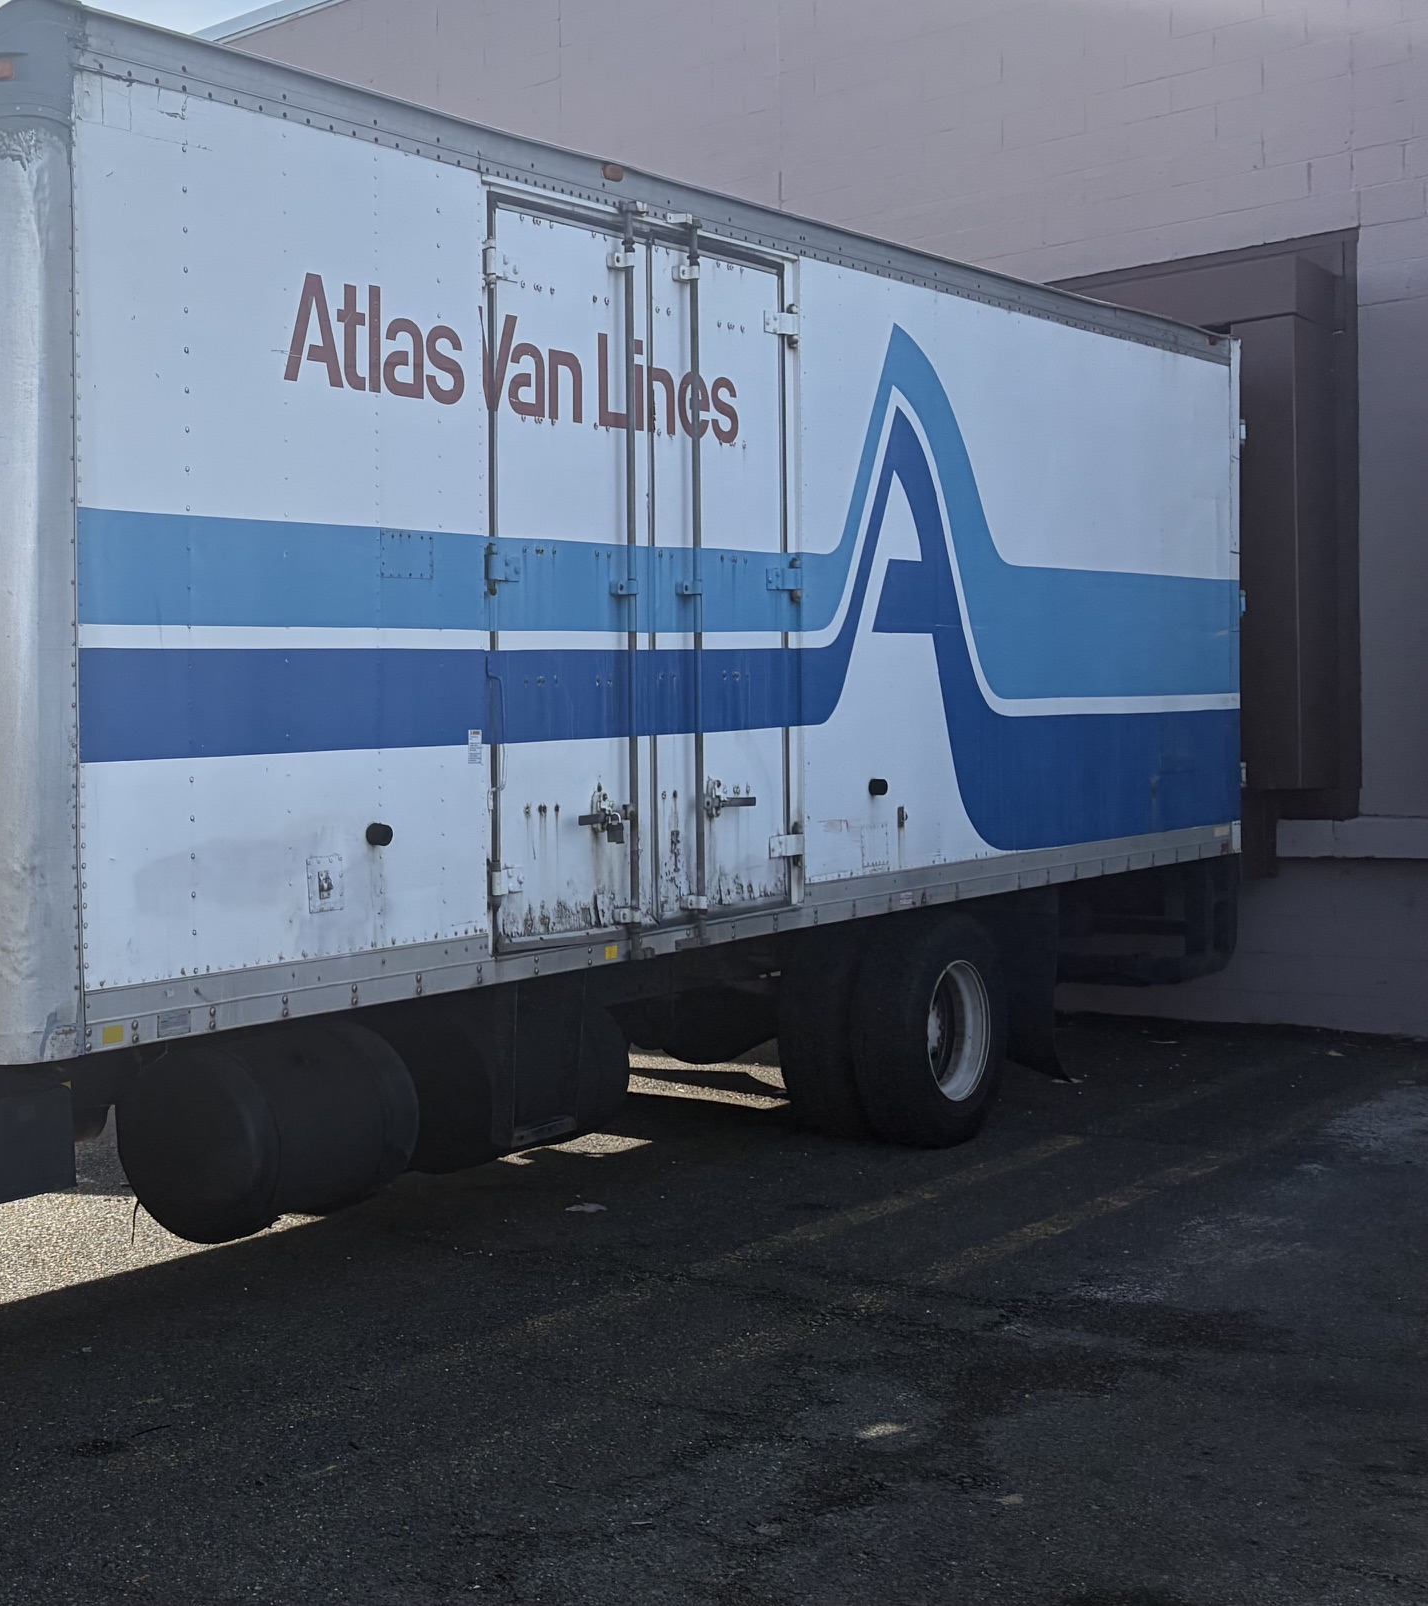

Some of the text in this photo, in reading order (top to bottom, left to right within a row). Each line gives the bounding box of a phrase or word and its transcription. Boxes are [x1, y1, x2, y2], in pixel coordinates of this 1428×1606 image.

[283, 272, 739, 444] Atlas Van Lines
